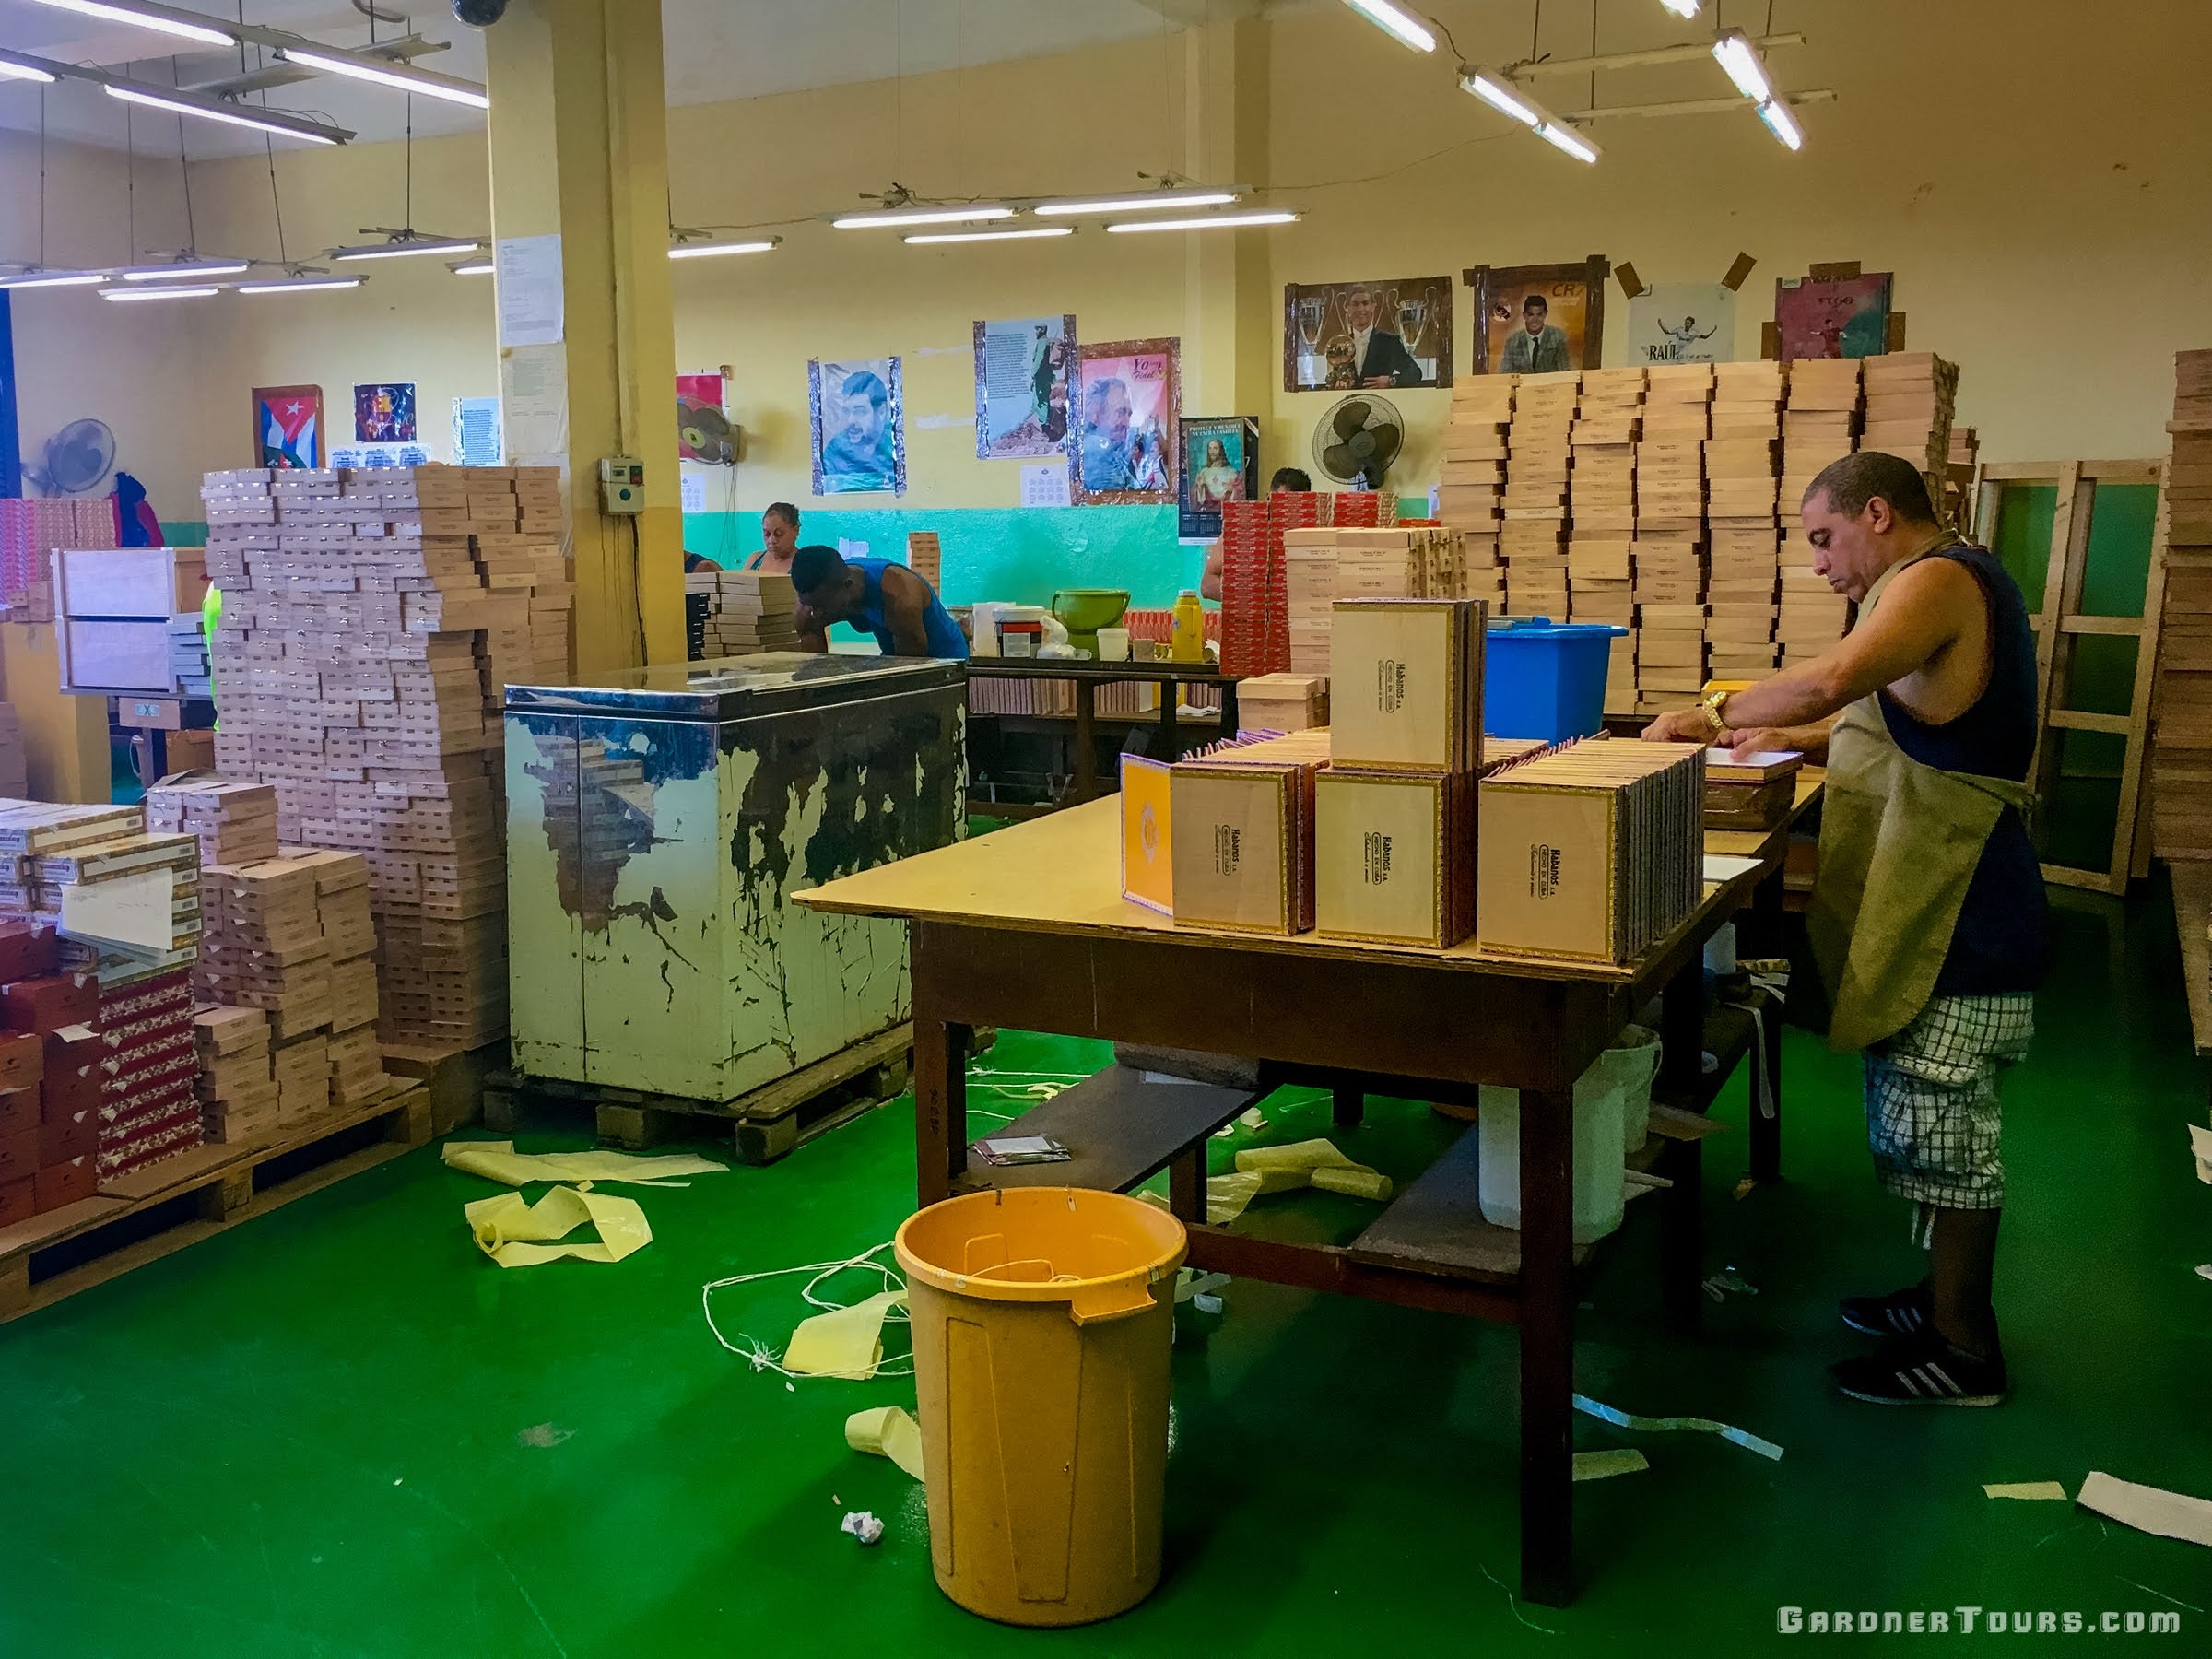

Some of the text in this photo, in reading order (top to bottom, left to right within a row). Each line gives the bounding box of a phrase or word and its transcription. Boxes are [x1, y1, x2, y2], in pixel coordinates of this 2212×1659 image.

[1552, 283, 1585, 297] CR7
[1134, 358, 1149, 371] Yo
[1648, 340, 1678, 361] RAÚL
[1395, 664, 1406, 699] Habanos
[1231, 829, 1241, 863] Habanos
[1382, 836, 1392, 871] Habanos
[1550, 849, 1561, 886] Habanos
